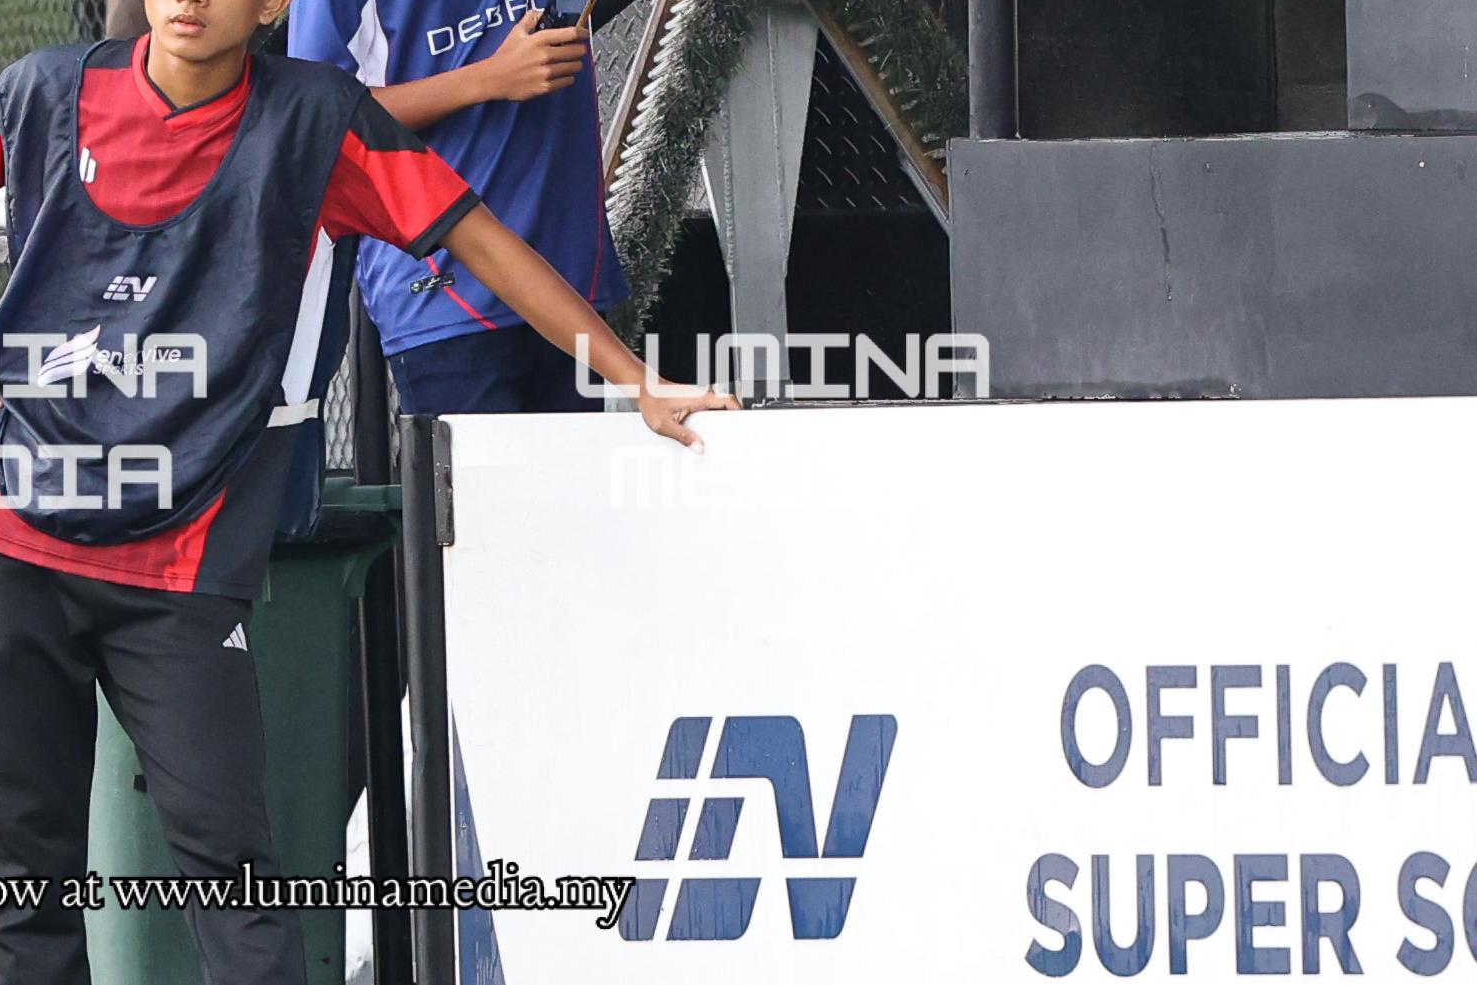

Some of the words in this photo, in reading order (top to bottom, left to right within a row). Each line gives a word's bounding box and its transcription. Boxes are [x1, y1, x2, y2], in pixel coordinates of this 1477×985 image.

[1060, 661, 1477, 789] OFFICIA
[1024, 852, 1365, 977] SUPER
[1395, 850, 1477, 978] S
